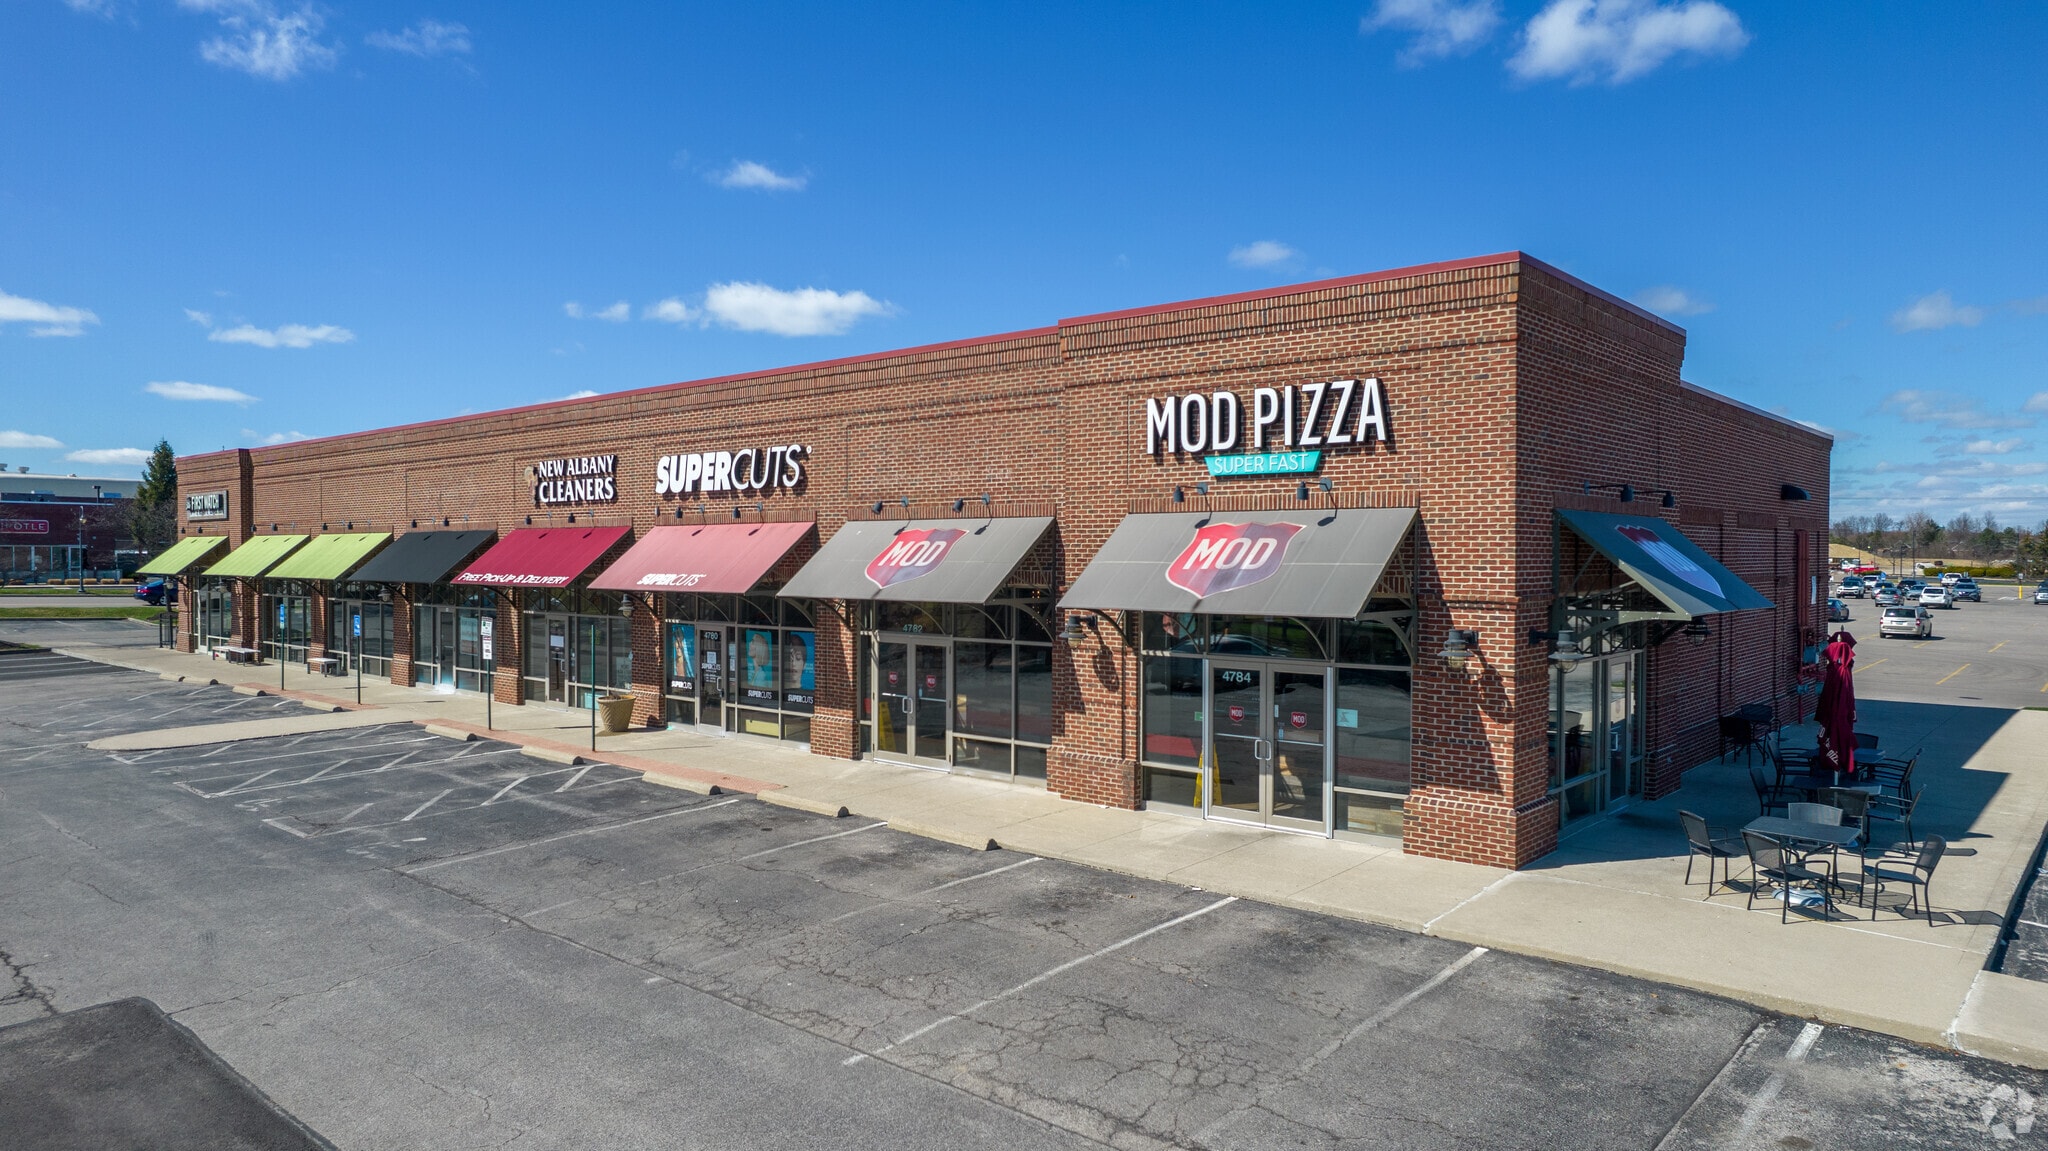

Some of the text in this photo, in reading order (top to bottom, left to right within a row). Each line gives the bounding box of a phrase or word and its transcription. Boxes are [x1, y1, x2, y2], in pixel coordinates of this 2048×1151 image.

[1147, 378, 1386, 454] MOD PIZZA
[539, 455, 615, 478] NEW ALBANY
[1214, 453, 1309, 474] SUPER FAST
[539, 477, 615, 502] CLEANERS
[877, 540, 947, 567] MOD
[1182, 537, 1278, 570] MOD
[458, 572, 484, 582] FREE
[521, 575, 569, 584] DELIVERY
[704, 631, 719, 640] 4780
[903, 623, 923, 633] 4782
[1222, 670, 1251, 683] 4784
[1231, 709, 1243, 718] MOD
[1292, 715, 1305, 723] MOD
